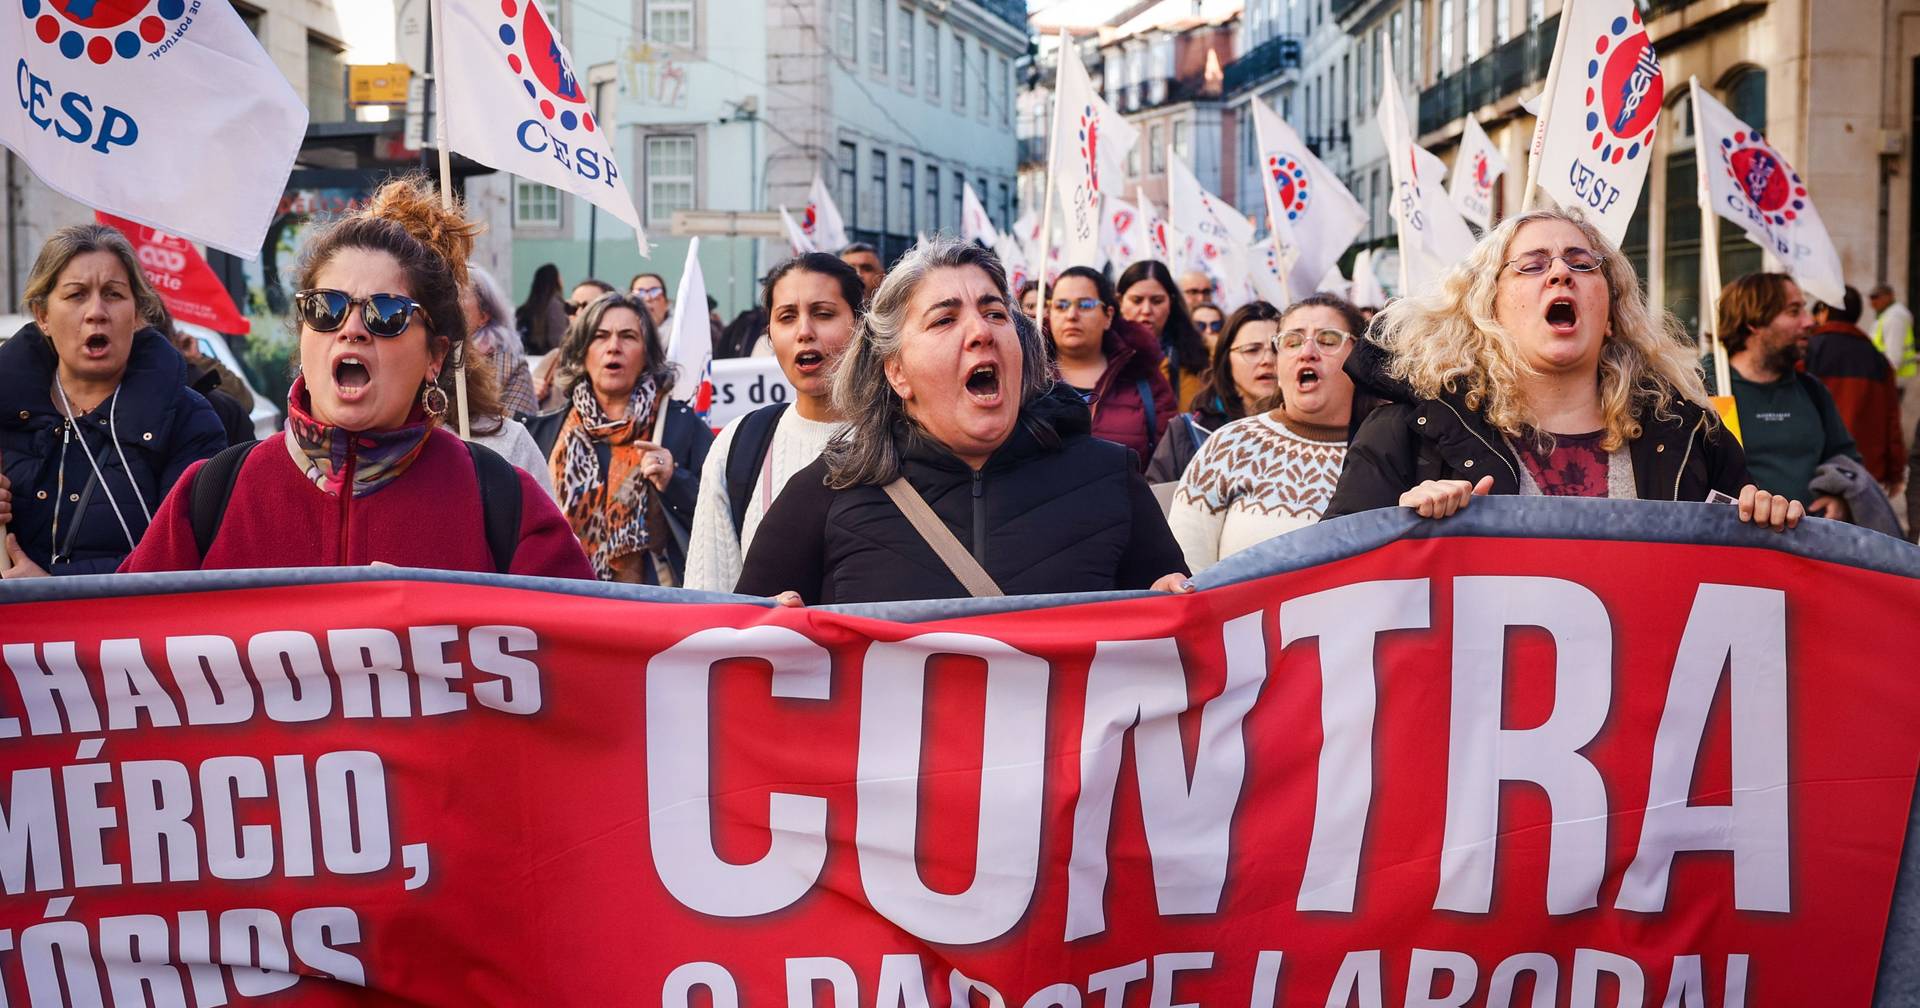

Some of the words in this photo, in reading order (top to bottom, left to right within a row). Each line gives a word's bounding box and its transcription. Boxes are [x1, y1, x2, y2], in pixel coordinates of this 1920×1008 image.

[148, 16, 193, 60] PORTUGAL
[189, 0, 202, 15] DE
[17, 58, 139, 154] CESP
[516, 119, 618, 188] CESP
[1569, 158, 1621, 214] CESP
[749, 374, 787, 403] do
[646, 575, 1792, 945] CONTRA
[0, 738, 431, 895] MÉRCIO,
